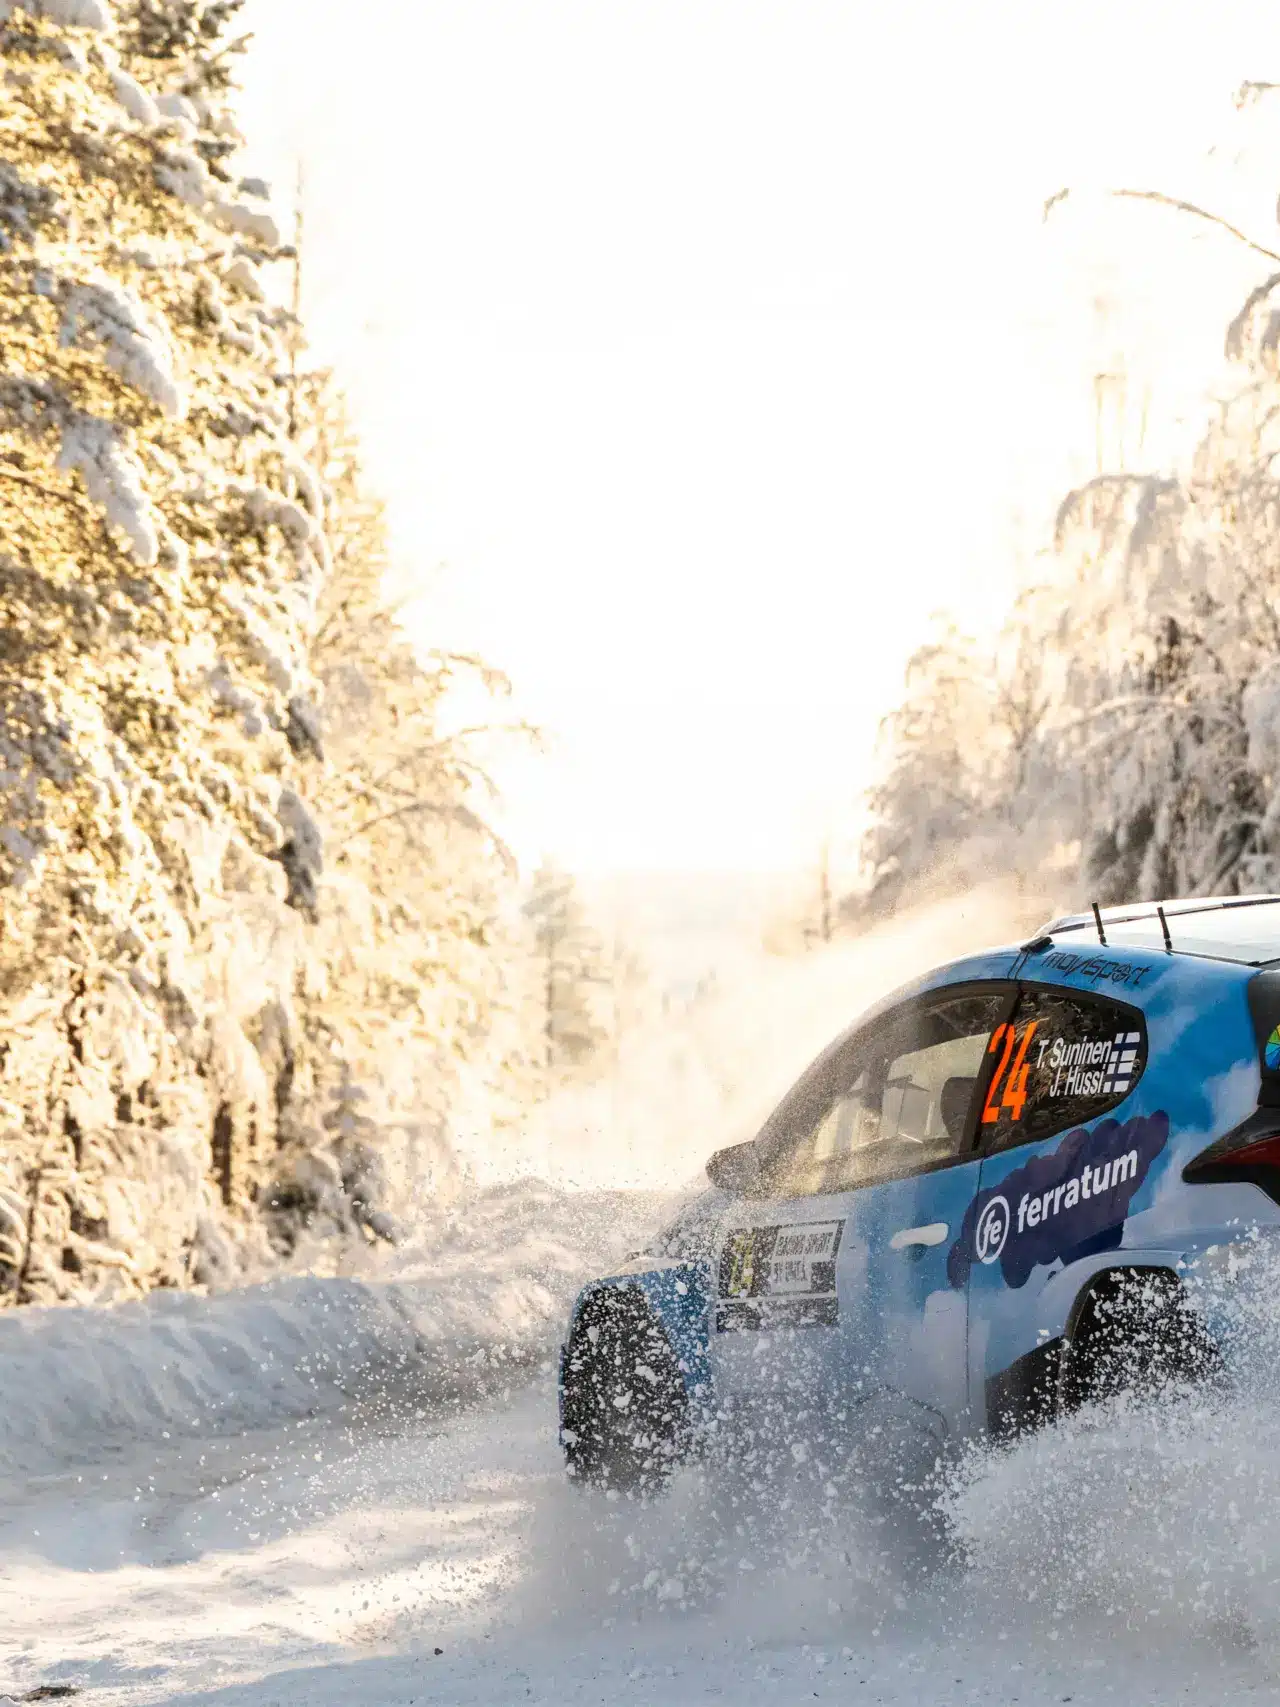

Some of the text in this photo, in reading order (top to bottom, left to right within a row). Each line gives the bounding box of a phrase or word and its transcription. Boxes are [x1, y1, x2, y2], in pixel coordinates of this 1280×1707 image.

[981, 1022, 1037, 1123] 24
[1036, 1036, 1111, 1069] T. Suninen
[1050, 1063, 1106, 1097] J. Hussi
[1018, 1150, 1138, 1233] ferratum
